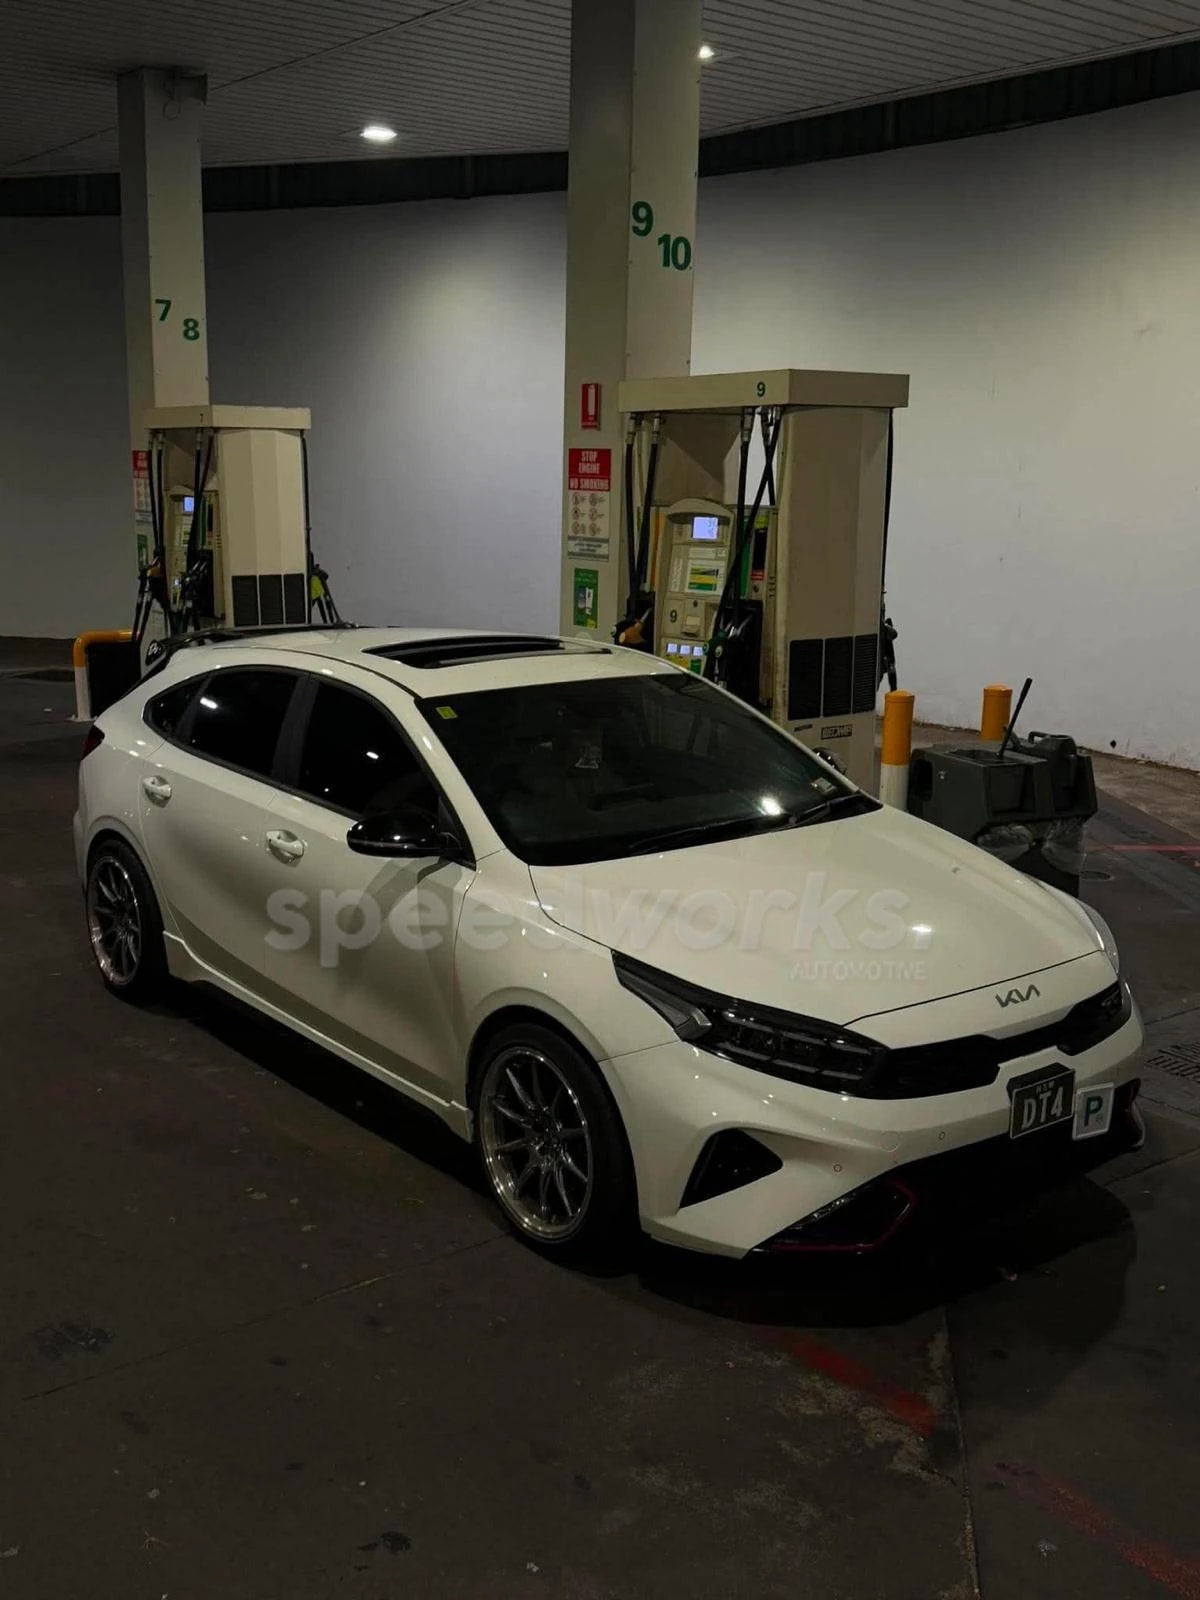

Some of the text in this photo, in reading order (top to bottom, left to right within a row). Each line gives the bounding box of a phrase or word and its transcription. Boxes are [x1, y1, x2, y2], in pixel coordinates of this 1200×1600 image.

[632, 201, 653, 237] 9
[658, 234, 691, 271] 10
[155, 299, 172, 322] 7
[182, 318, 200, 341] 8
[756, 382, 766, 398] 9
[581, 450, 598, 462] STOP
[578, 463, 600, 474] ENGINE
[569, 478, 609, 490] NO SMOKING
[669, 610, 677, 623] 9
[995, 984, 1040, 1008] KIA
[1021, 1086, 1064, 1130] DT4
[1084, 1096, 1103, 1127] P
